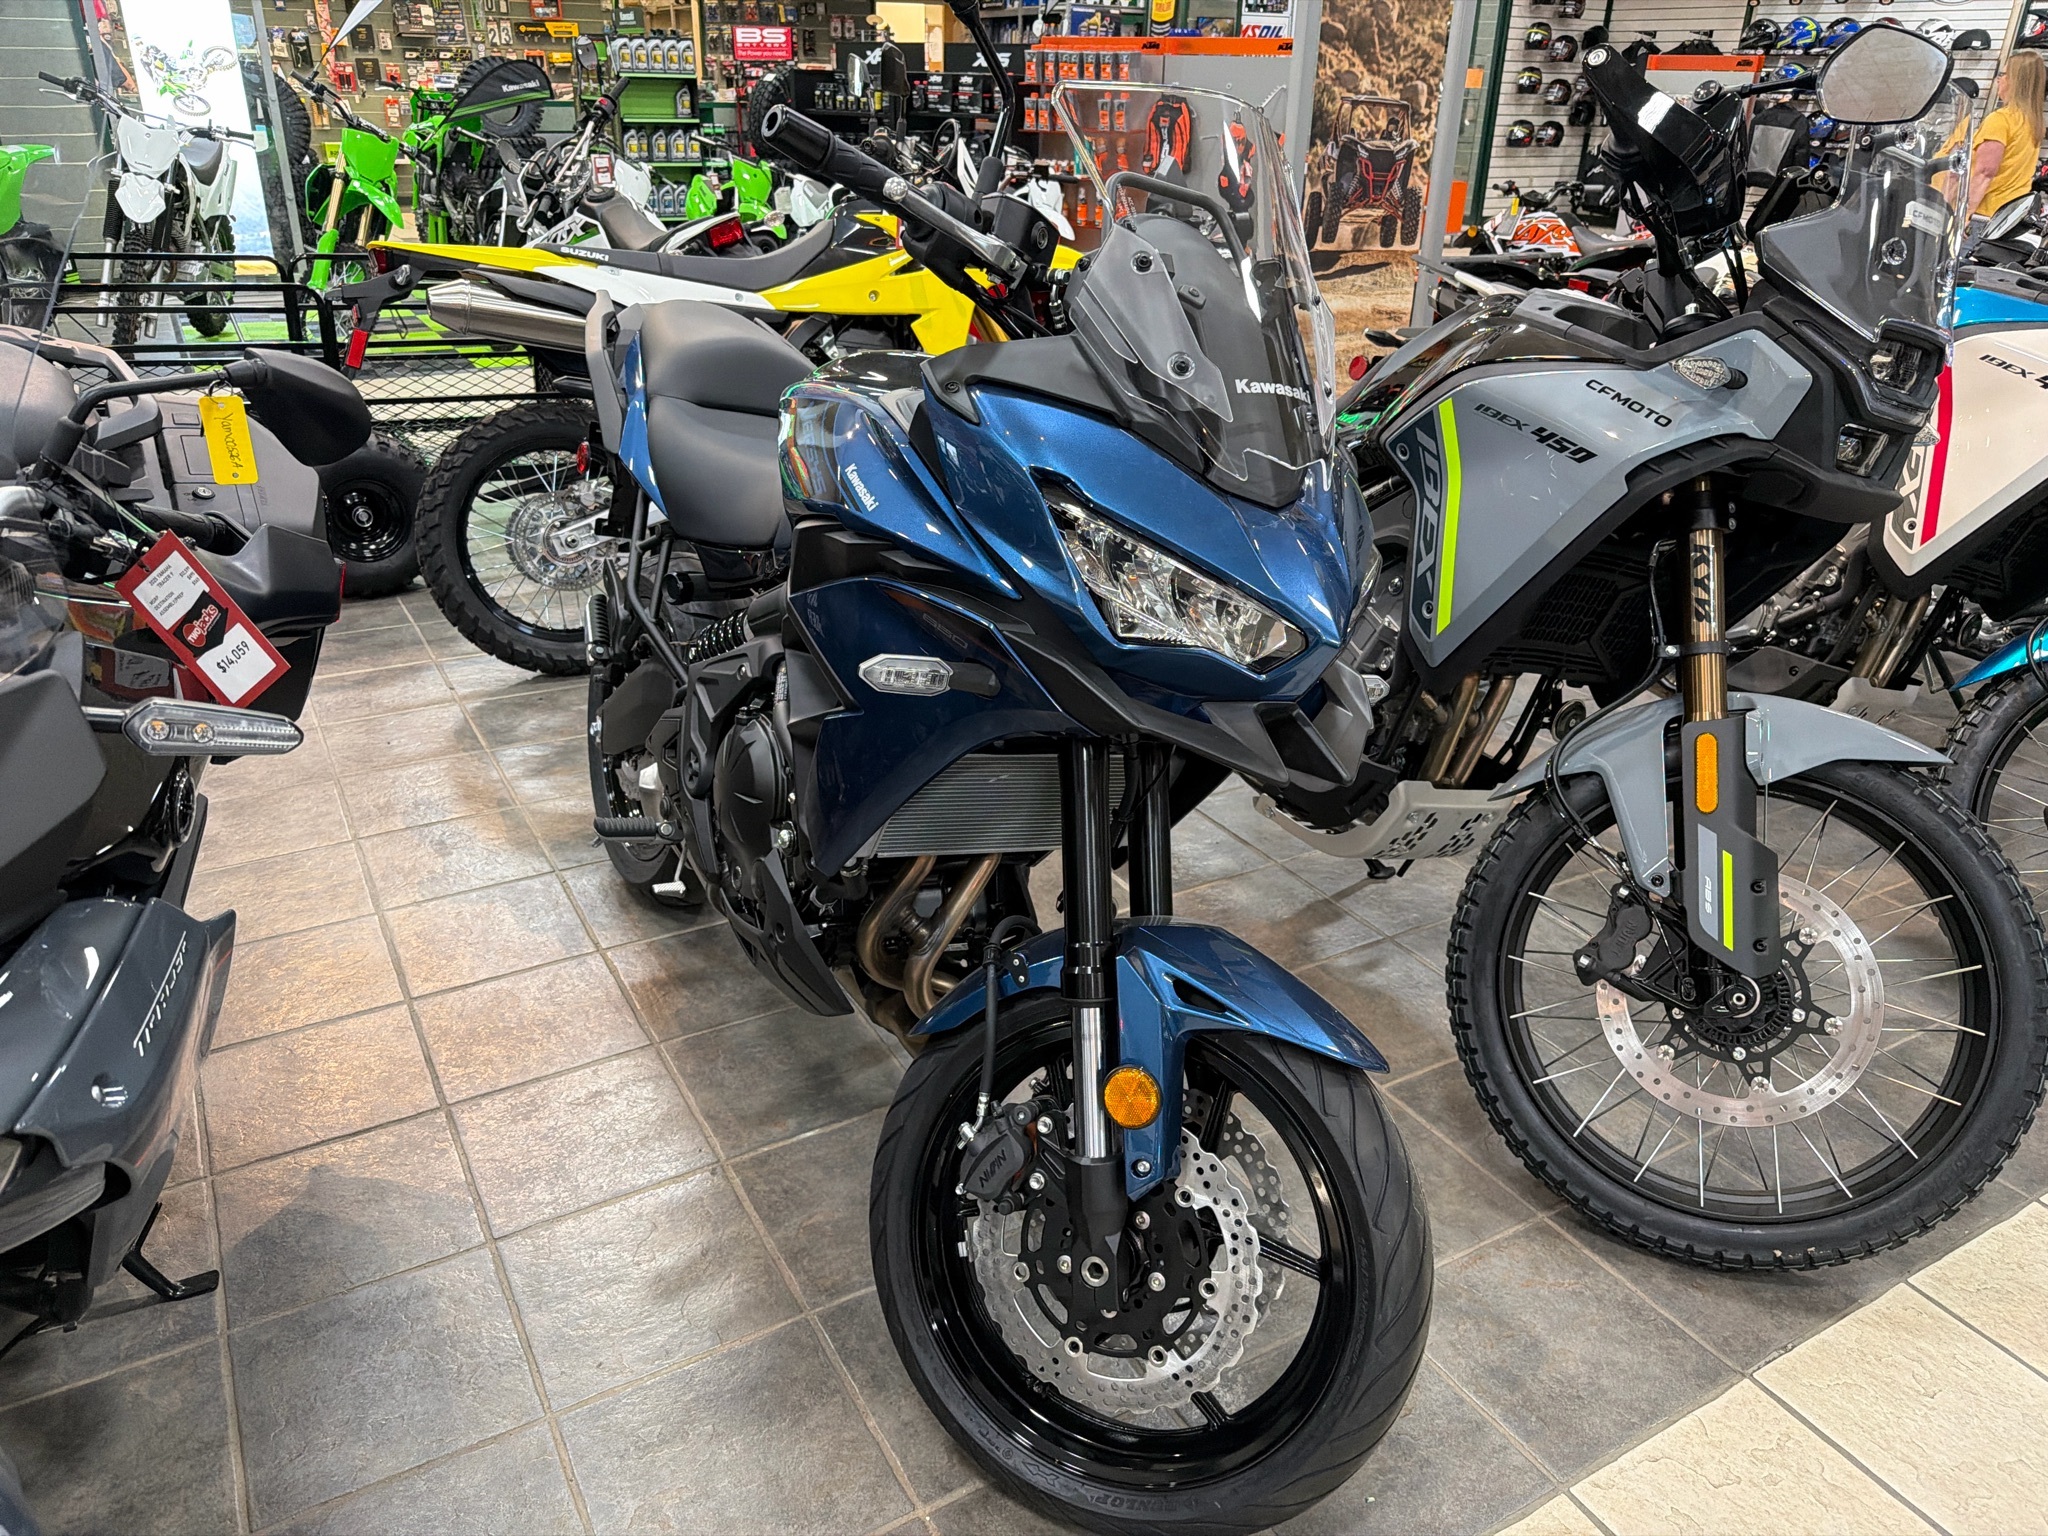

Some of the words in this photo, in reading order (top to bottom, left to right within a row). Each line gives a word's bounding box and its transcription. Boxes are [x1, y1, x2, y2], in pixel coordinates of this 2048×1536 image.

[489, 28, 498, 46] 2
[502, 28, 512, 45] 3
[736, 28, 787, 43] BS
[972, 52, 1012, 67] XS
[501, 79, 540, 93] Kawasaki
[560, 246, 609, 262] SUZUKI
[1979, 354, 2036, 378] IBEX
[1235, 378, 1311, 404] Kawasaki
[1585, 379, 1673, 428] CFMOTO
[1474, 403, 1530, 432] IBEX
[1530, 426, 1598, 464] 450
[845, 463, 879, 512] Kawasaki
[1415, 427, 1442, 598] IBEX
[156, 564, 172, 579] YAMAHA
[156, 574, 172, 588] TRACER
[1693, 544, 1712, 623] KYB
[149, 595, 159, 605] MSRP
[154, 591, 175, 611] DESTINATION
[159, 592, 185, 616] ASSEMBLY/PREP
[193, 603, 219, 636] jacks
[187, 627, 202, 642] TWO
[216, 640, 251, 674] $14,059
[1704, 875, 1712, 915] ABS
